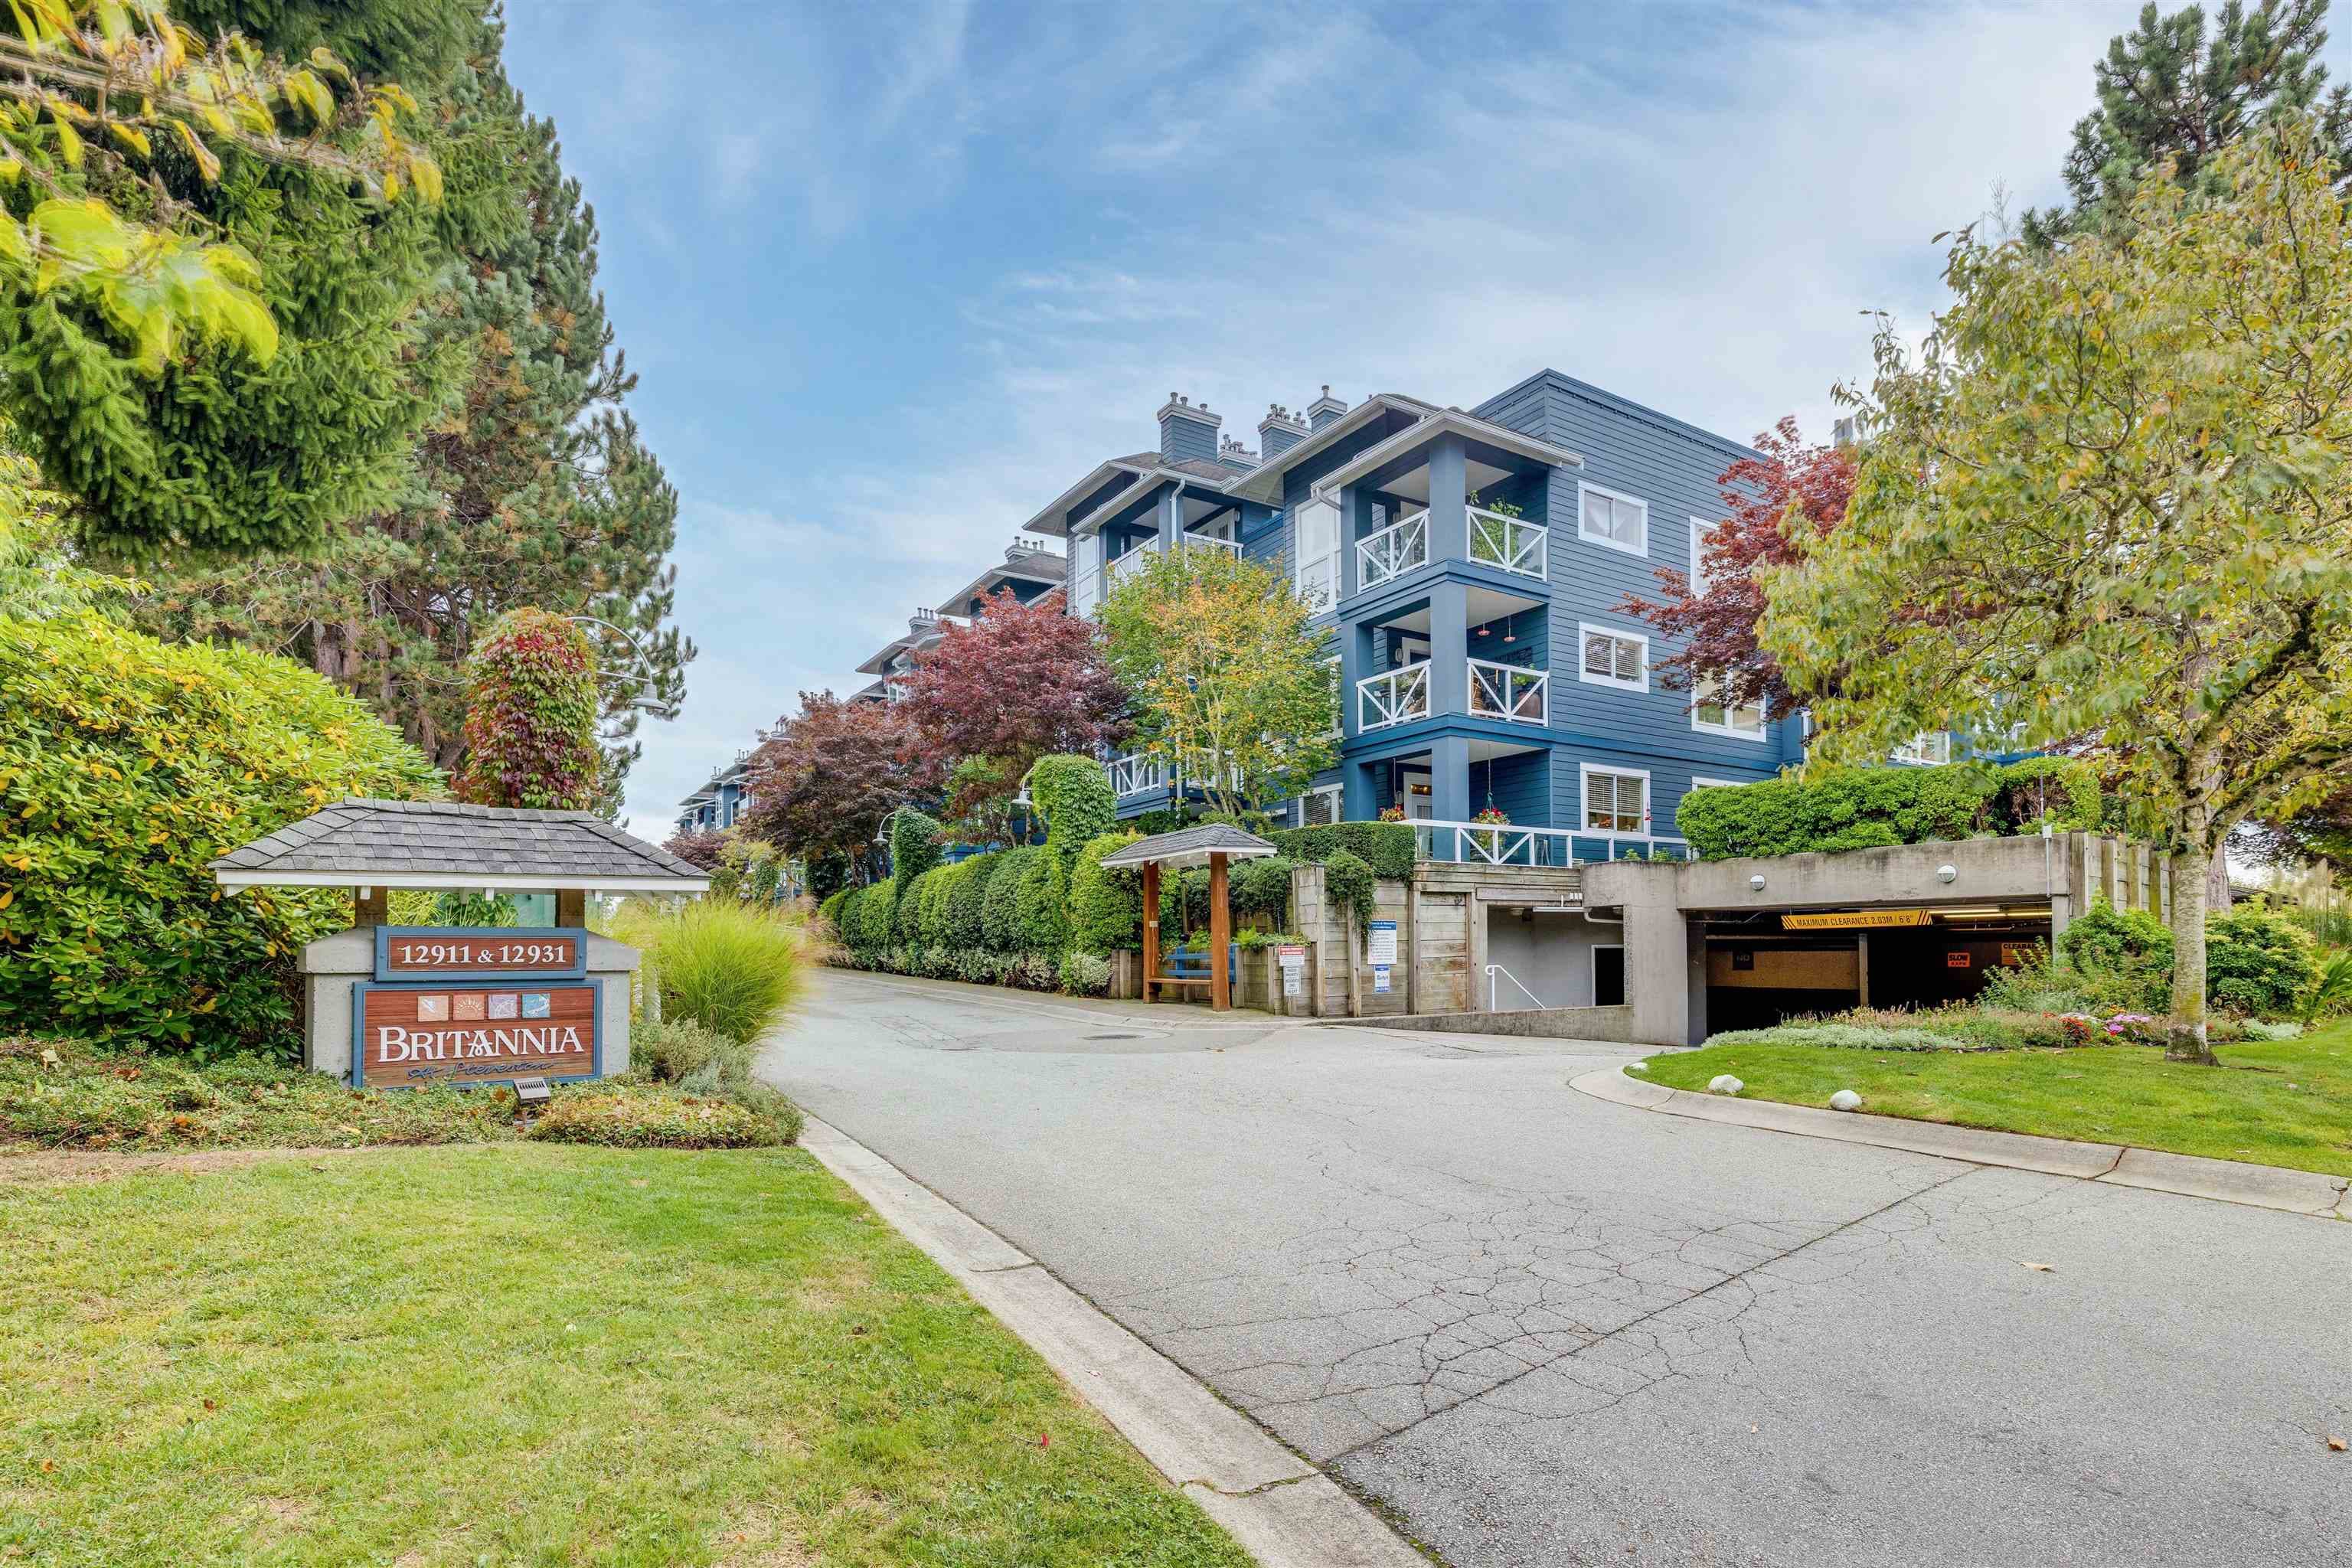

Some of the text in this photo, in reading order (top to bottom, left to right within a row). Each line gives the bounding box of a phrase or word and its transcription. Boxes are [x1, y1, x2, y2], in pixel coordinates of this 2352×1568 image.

[1831, 916, 1869, 926] CLEARANCE
[1871, 916, 1893, 924] 2.03M
[399, 945, 566, 965] 12911 & 12931
[377, 1026, 584, 1062] BRITANNIA
